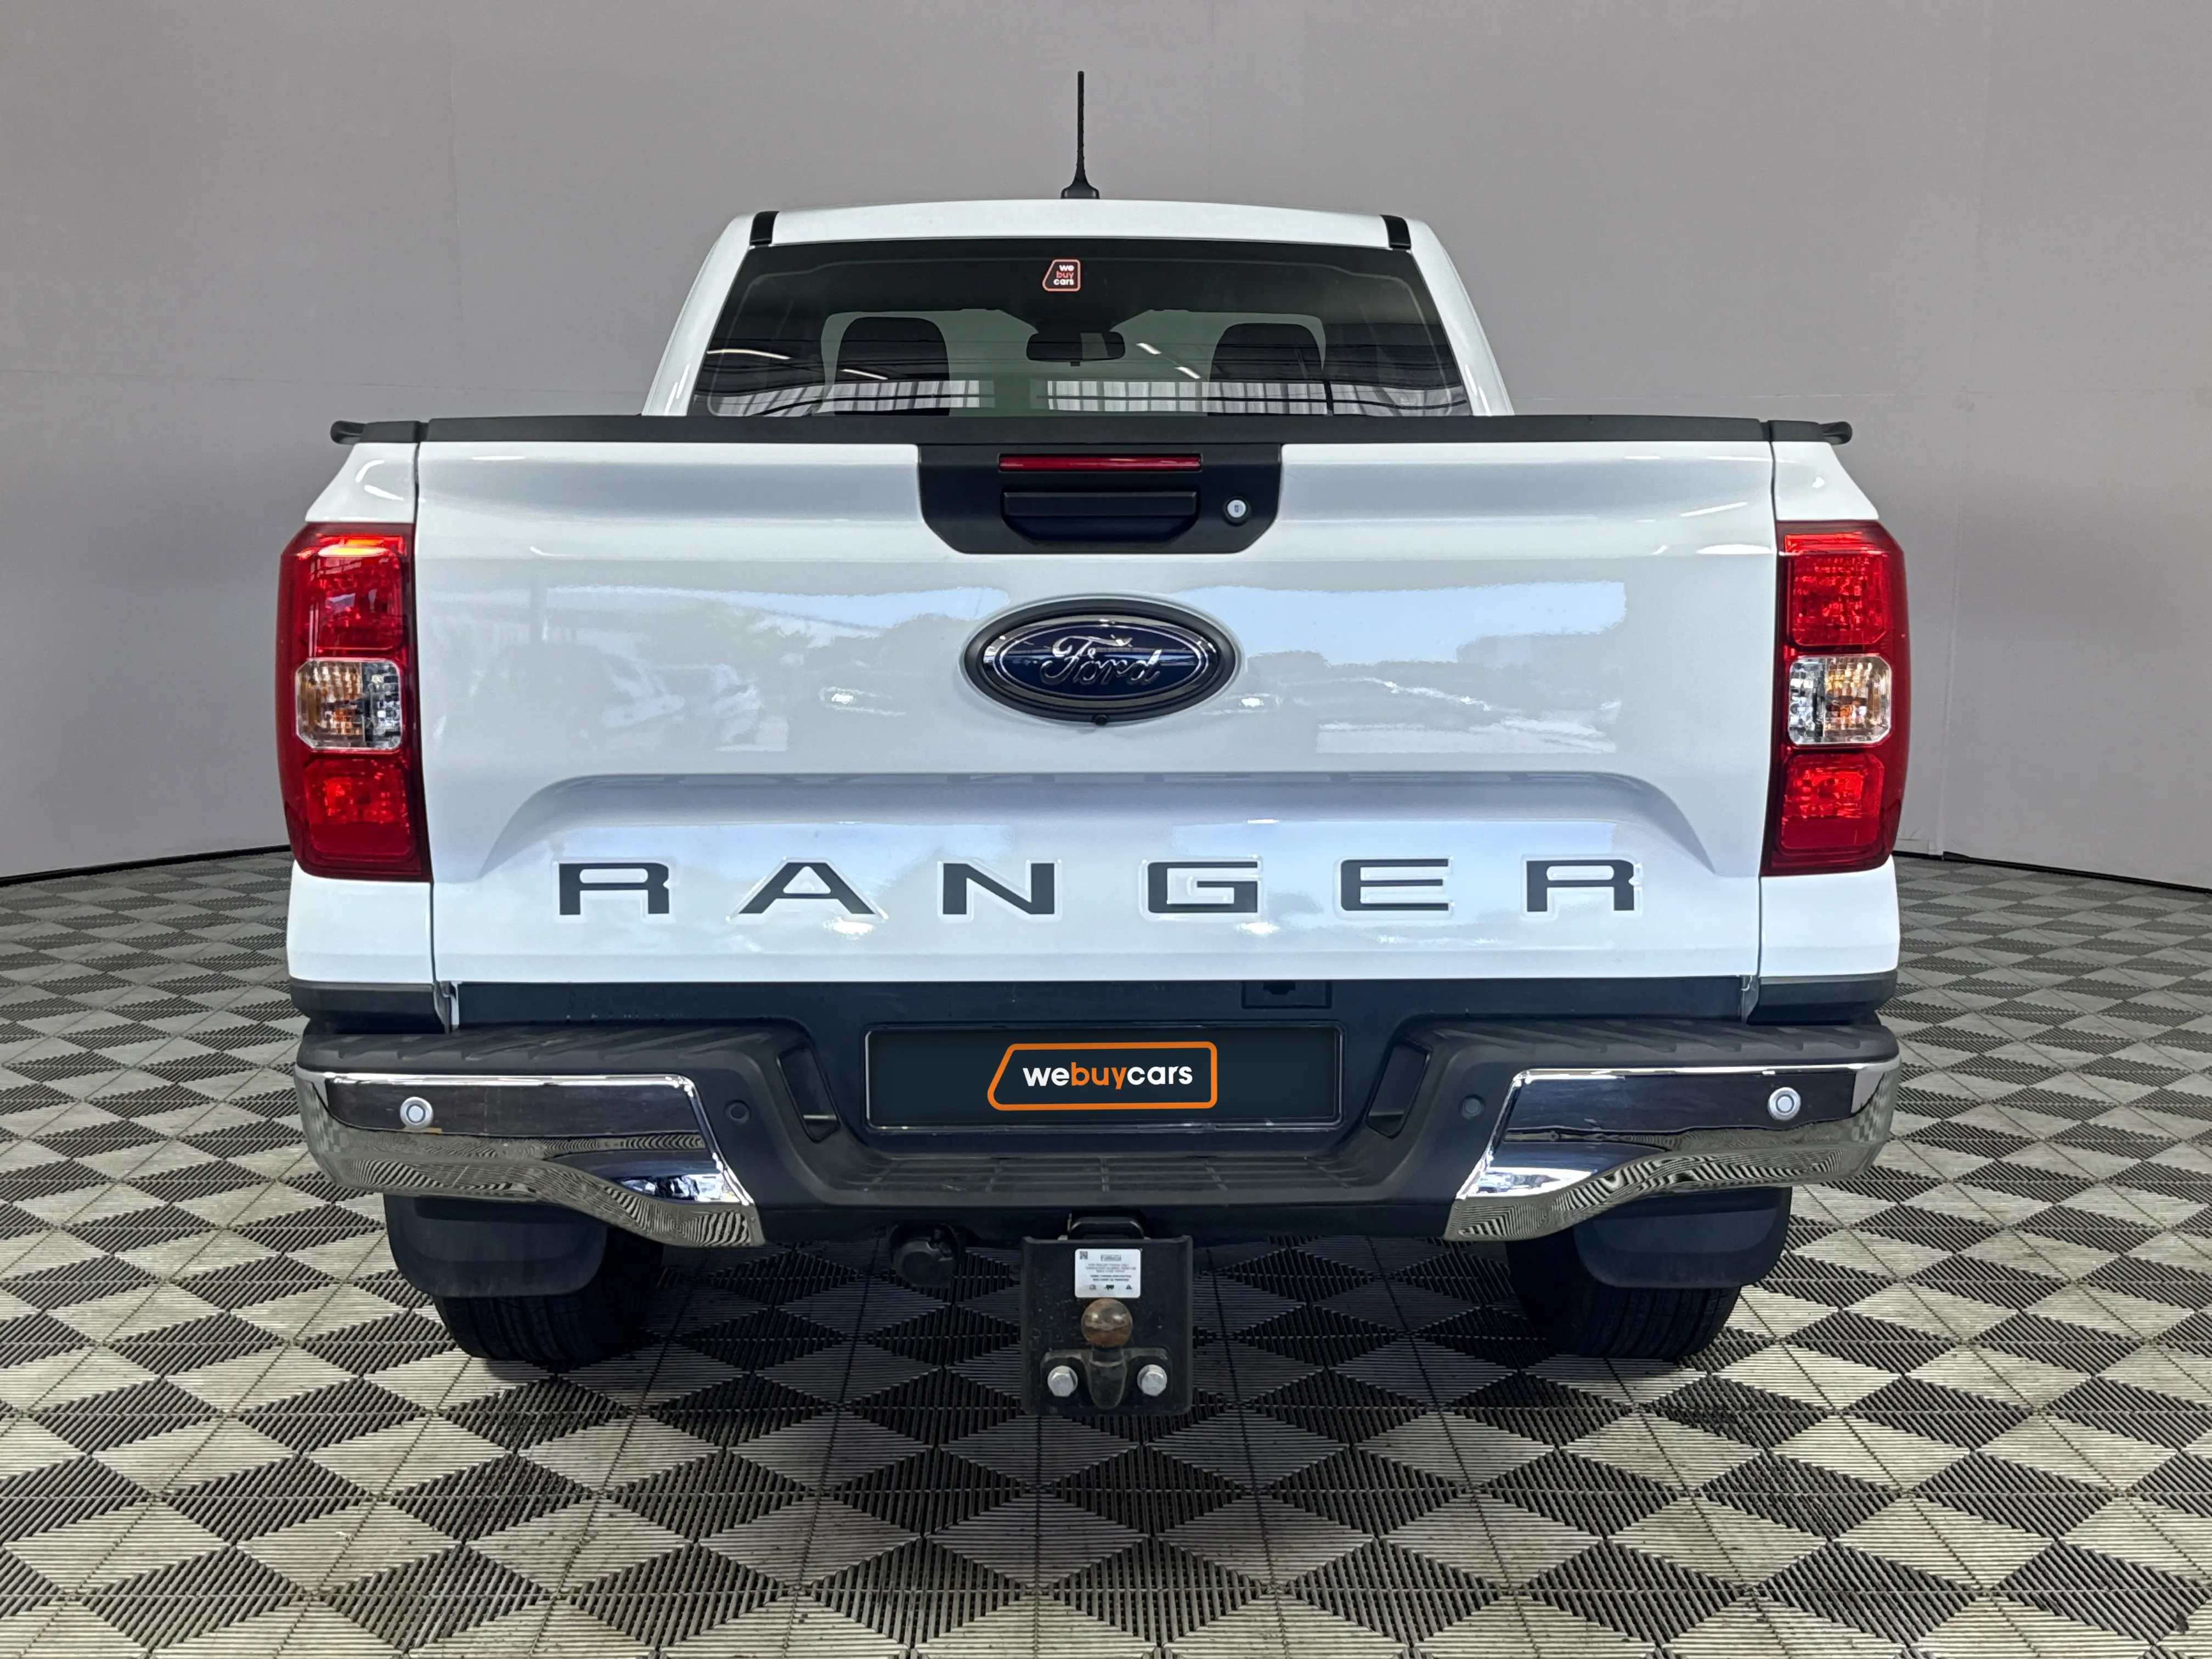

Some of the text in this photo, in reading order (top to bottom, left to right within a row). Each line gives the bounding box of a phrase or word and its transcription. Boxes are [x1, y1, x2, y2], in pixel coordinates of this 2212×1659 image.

[1056, 270, 1074, 279] buy
[1040, 634, 1161, 685] Ford
[558, 857, 1635, 916] RANGER
